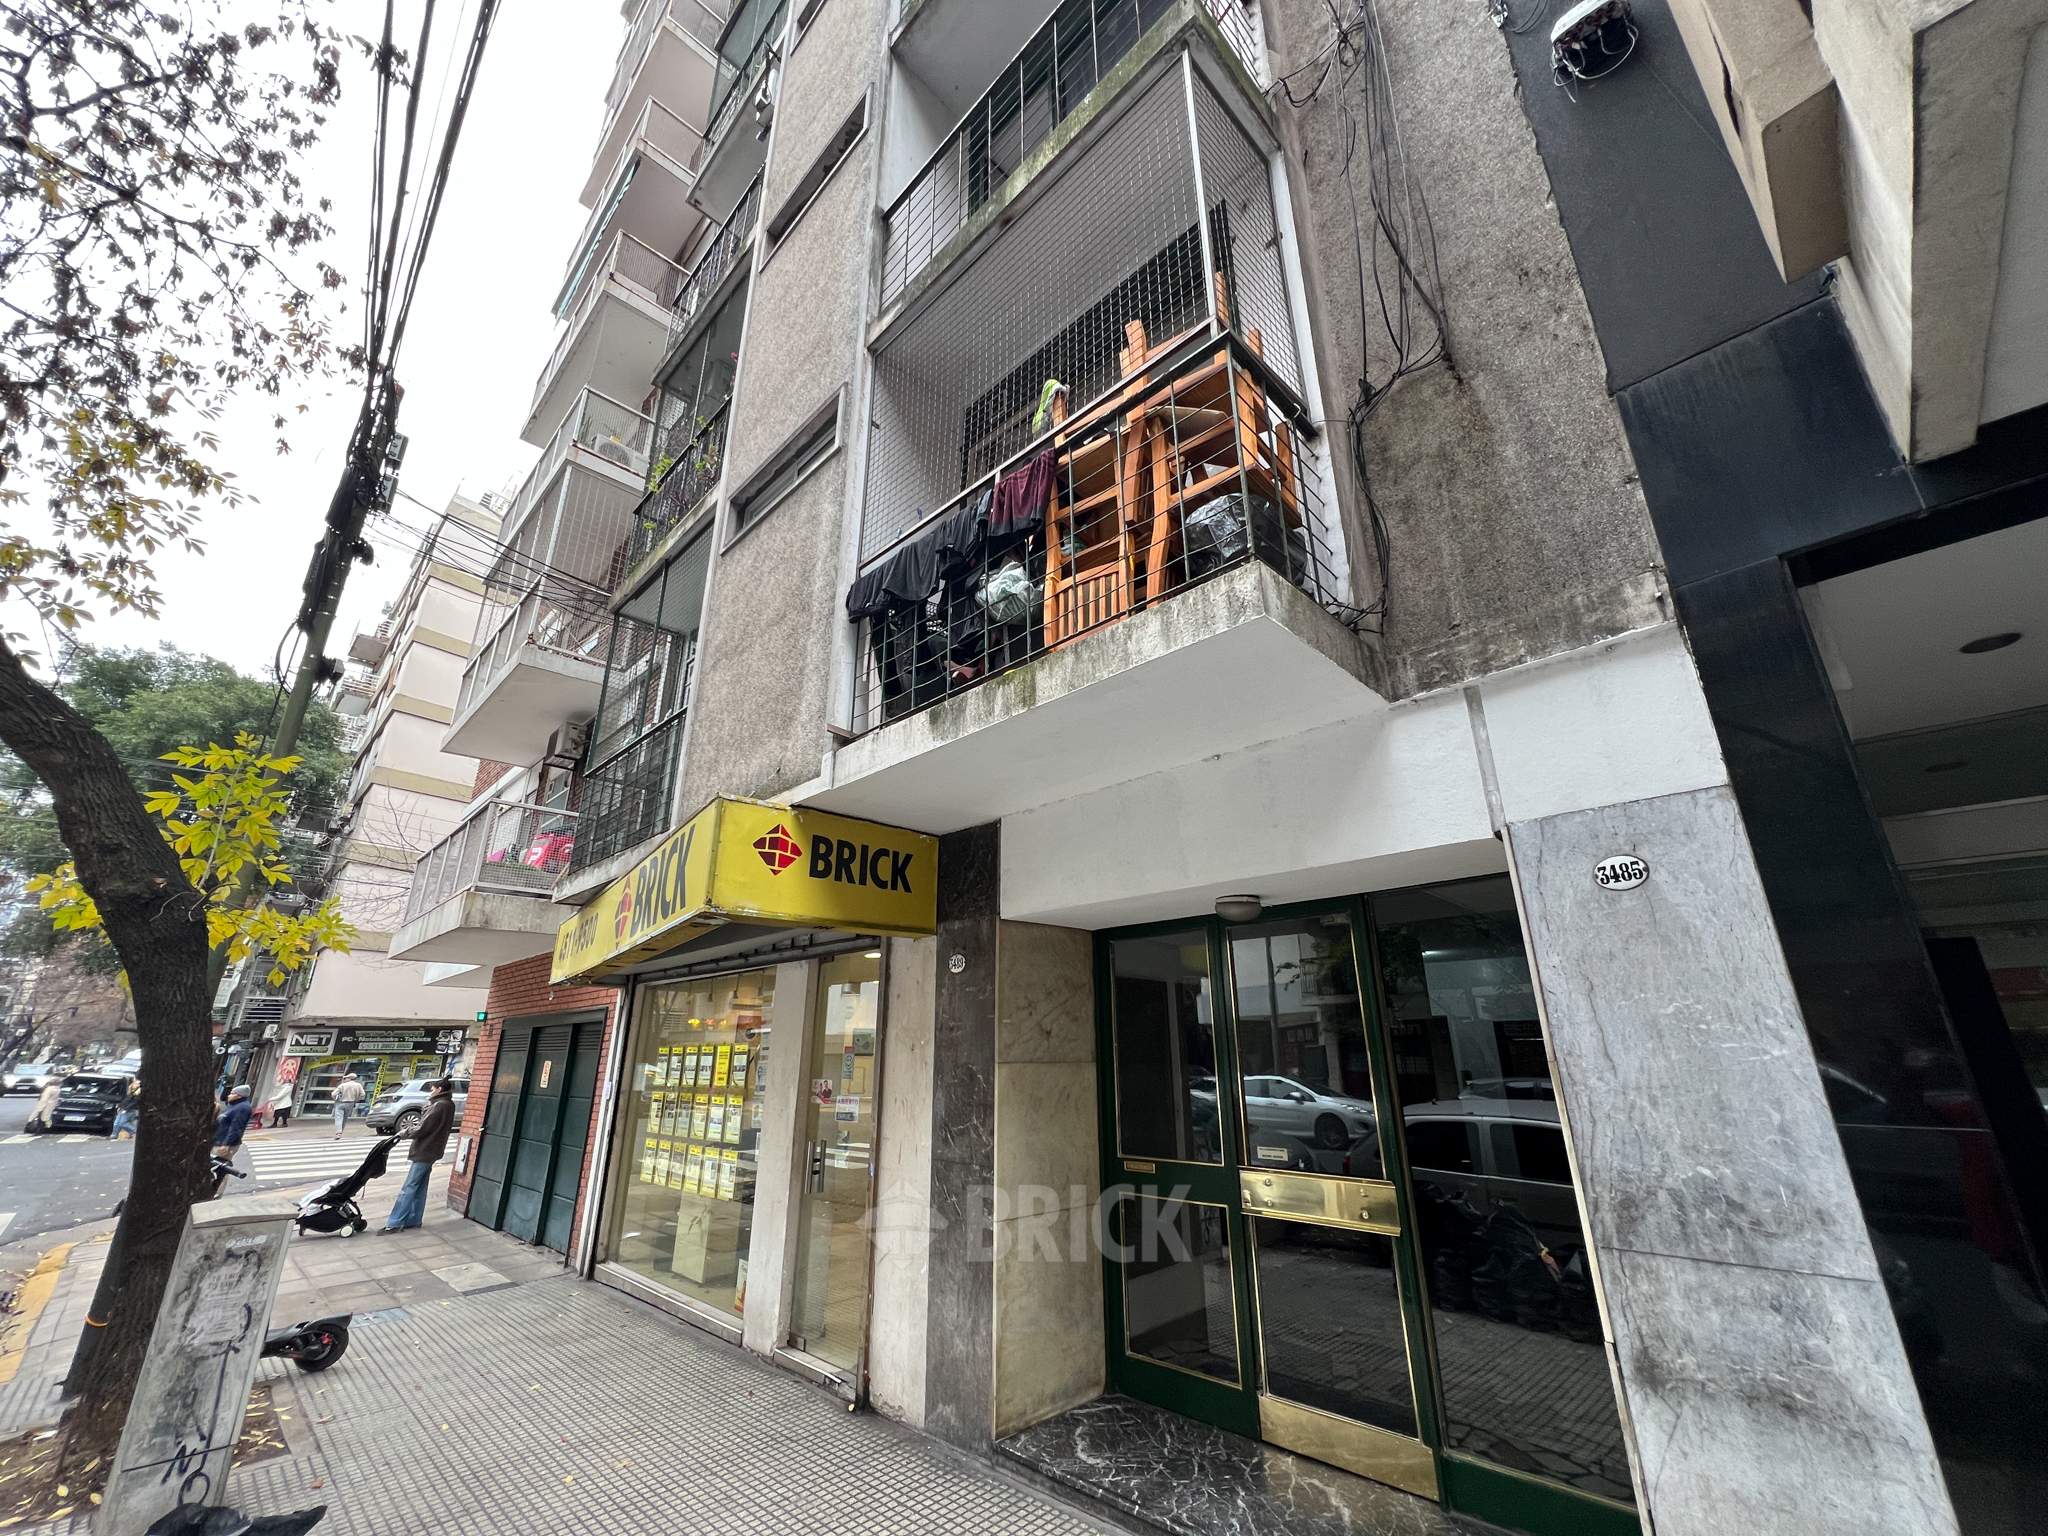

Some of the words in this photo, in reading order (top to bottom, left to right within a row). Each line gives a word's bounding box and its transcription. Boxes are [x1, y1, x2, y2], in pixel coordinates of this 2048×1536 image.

[629, 822, 697, 938] BRICK
[809, 834, 914, 894] BRICK
[1597, 860, 1644, 885] 3485
[291, 1033, 331, 1046] NET
